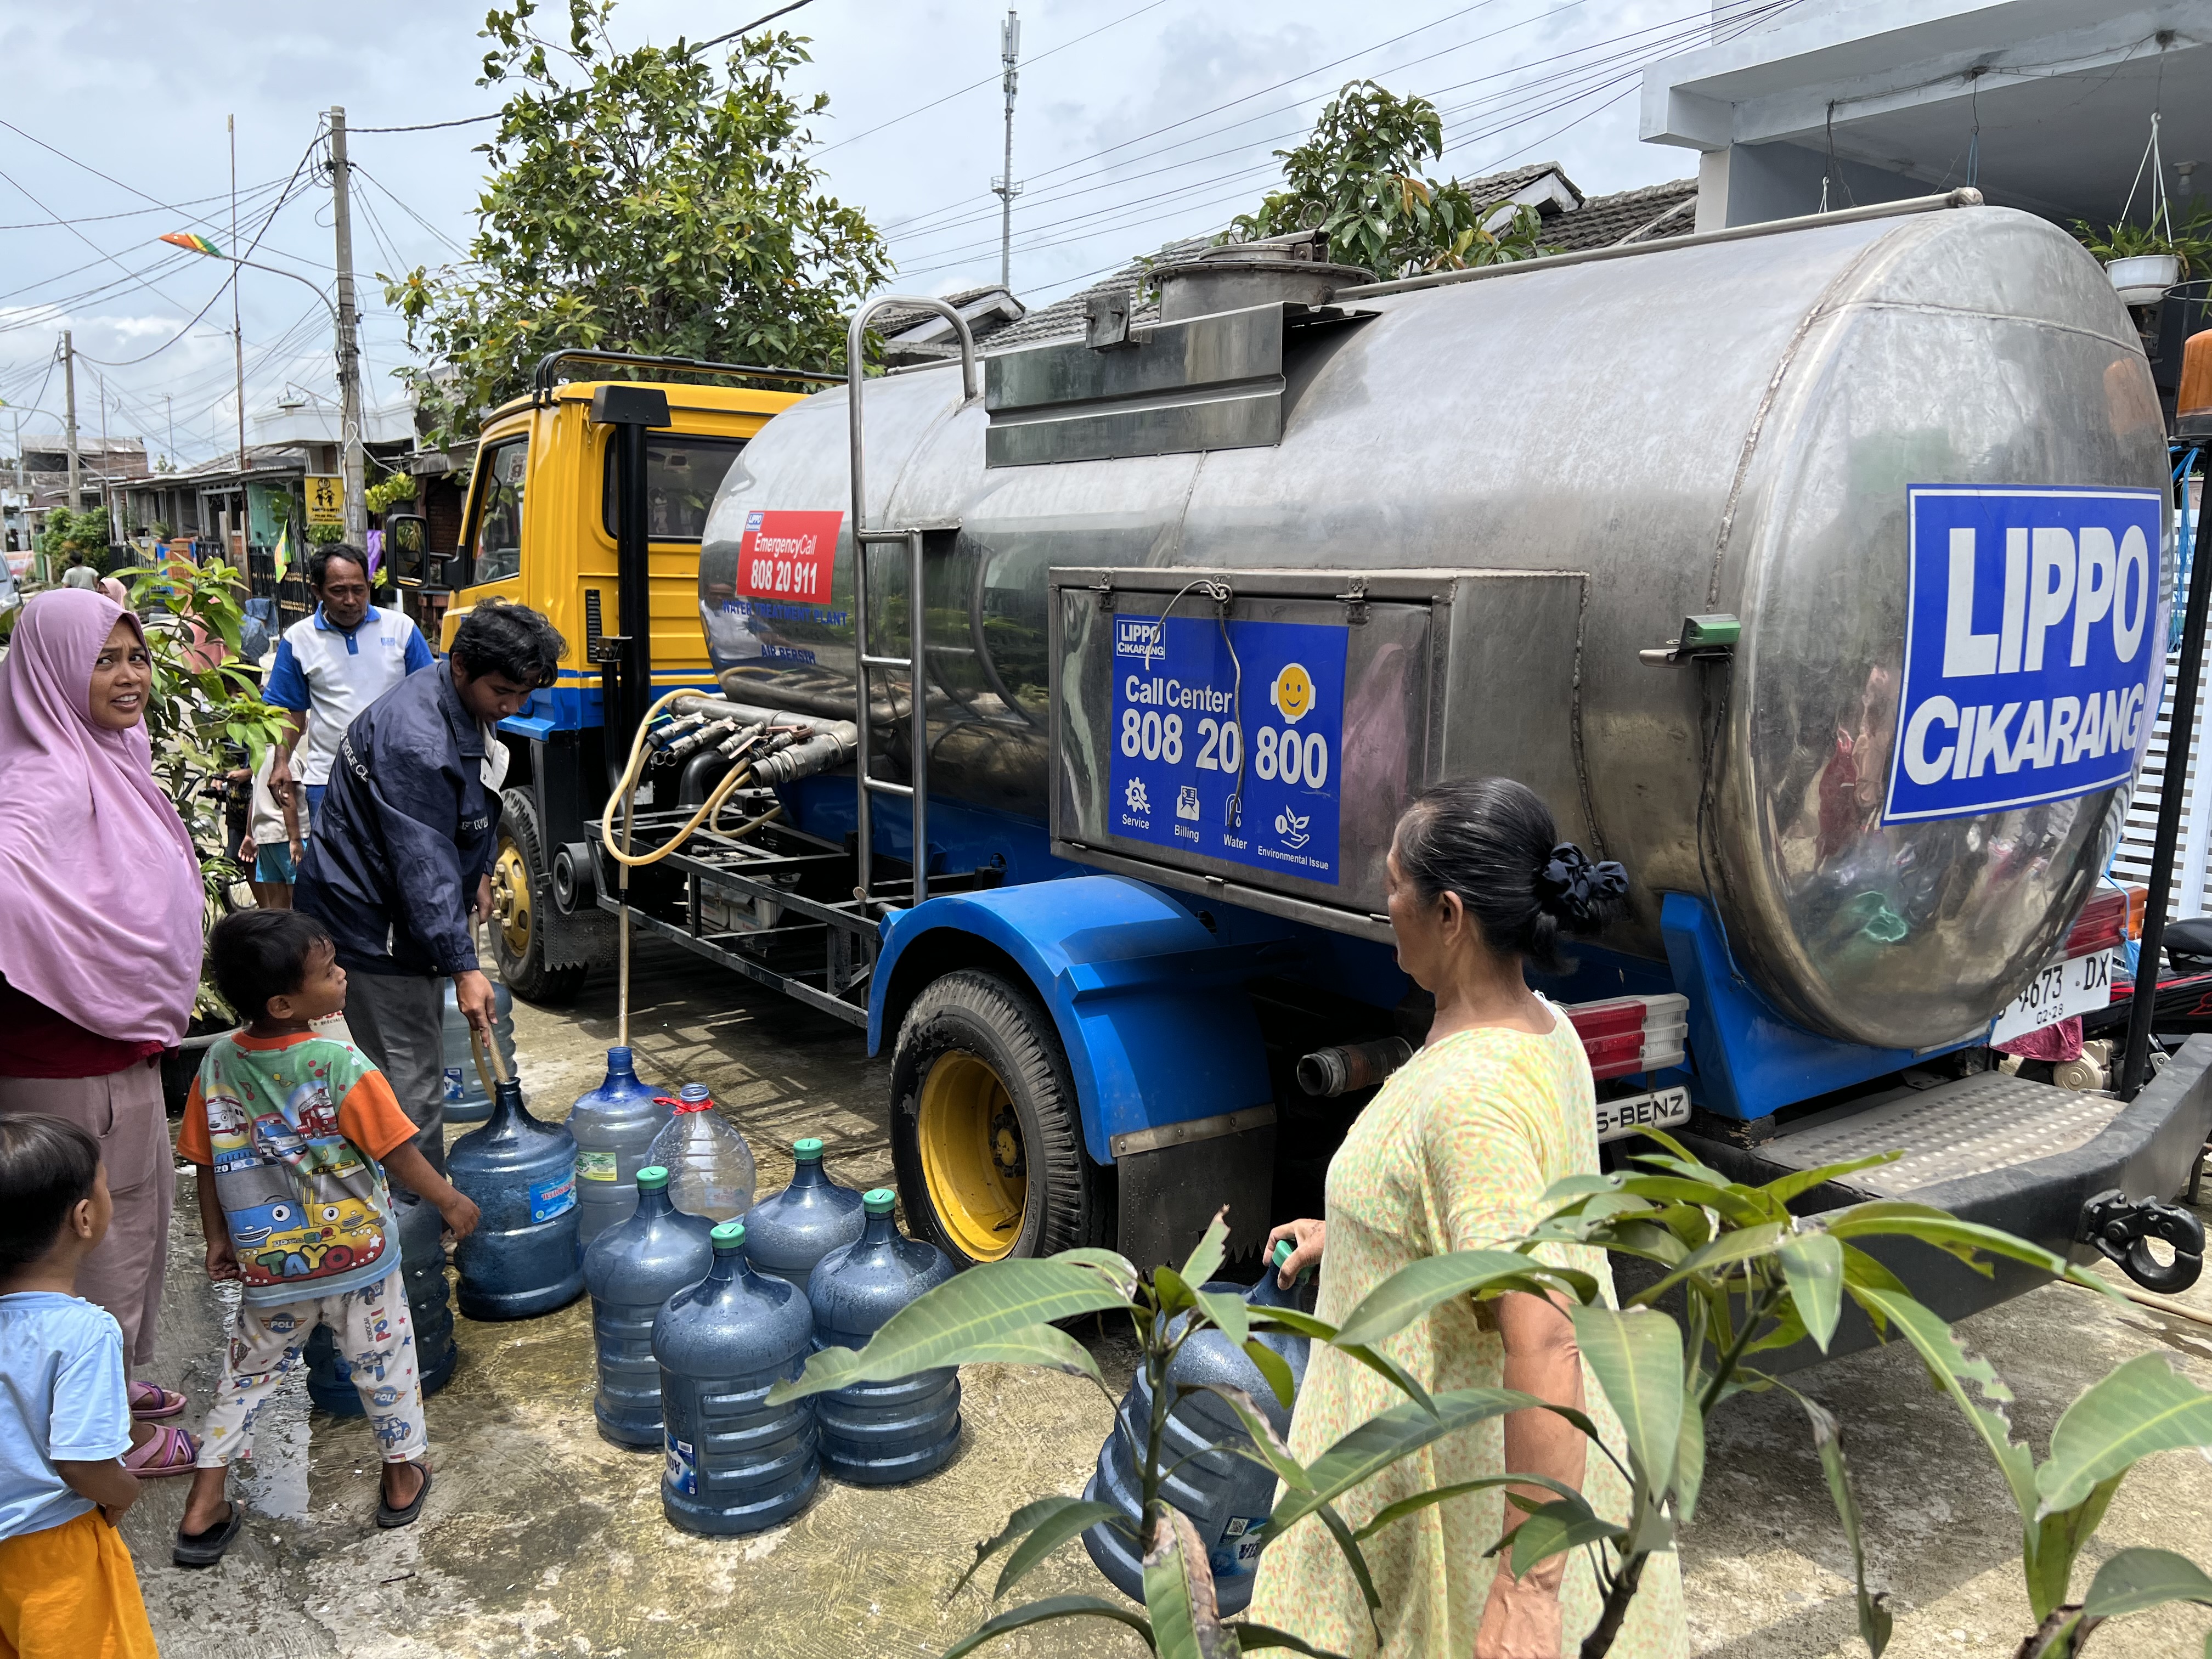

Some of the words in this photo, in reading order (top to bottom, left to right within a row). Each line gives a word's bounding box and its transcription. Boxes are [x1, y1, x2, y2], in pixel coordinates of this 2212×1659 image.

[748, 514, 762, 523] LIPPO
[751, 559, 773, 590] 808
[775, 561, 791, 592] 20
[794, 562, 817, 594] 911
[1943, 524, 2148, 678] LIPPO
[723, 599, 752, 616] WATER
[754, 603, 811, 623] TREATMENT
[814, 608, 847, 627] PLANT
[1121, 624, 1160, 644] LIPPO
[761, 645, 776, 658] AIR
[1118, 642, 1164, 656] CIKARANG
[1904, 683, 2144, 785] CIKARANG
[1121, 708, 1183, 764] 808
[1195, 718, 1241, 774] 20
[1255, 726, 1328, 788] 800
[1122, 814, 1149, 829] Service
[1175, 825, 1199, 843] Billing
[1224, 834, 1248, 850] Water
[1258, 846, 1308, 865] Environmental
[1309, 856, 1329, 870] Issue
[2083, 952, 2110, 991] DX
[256, 1244, 354, 1277] TAYO
[374, 1393, 396, 1402] POLI
